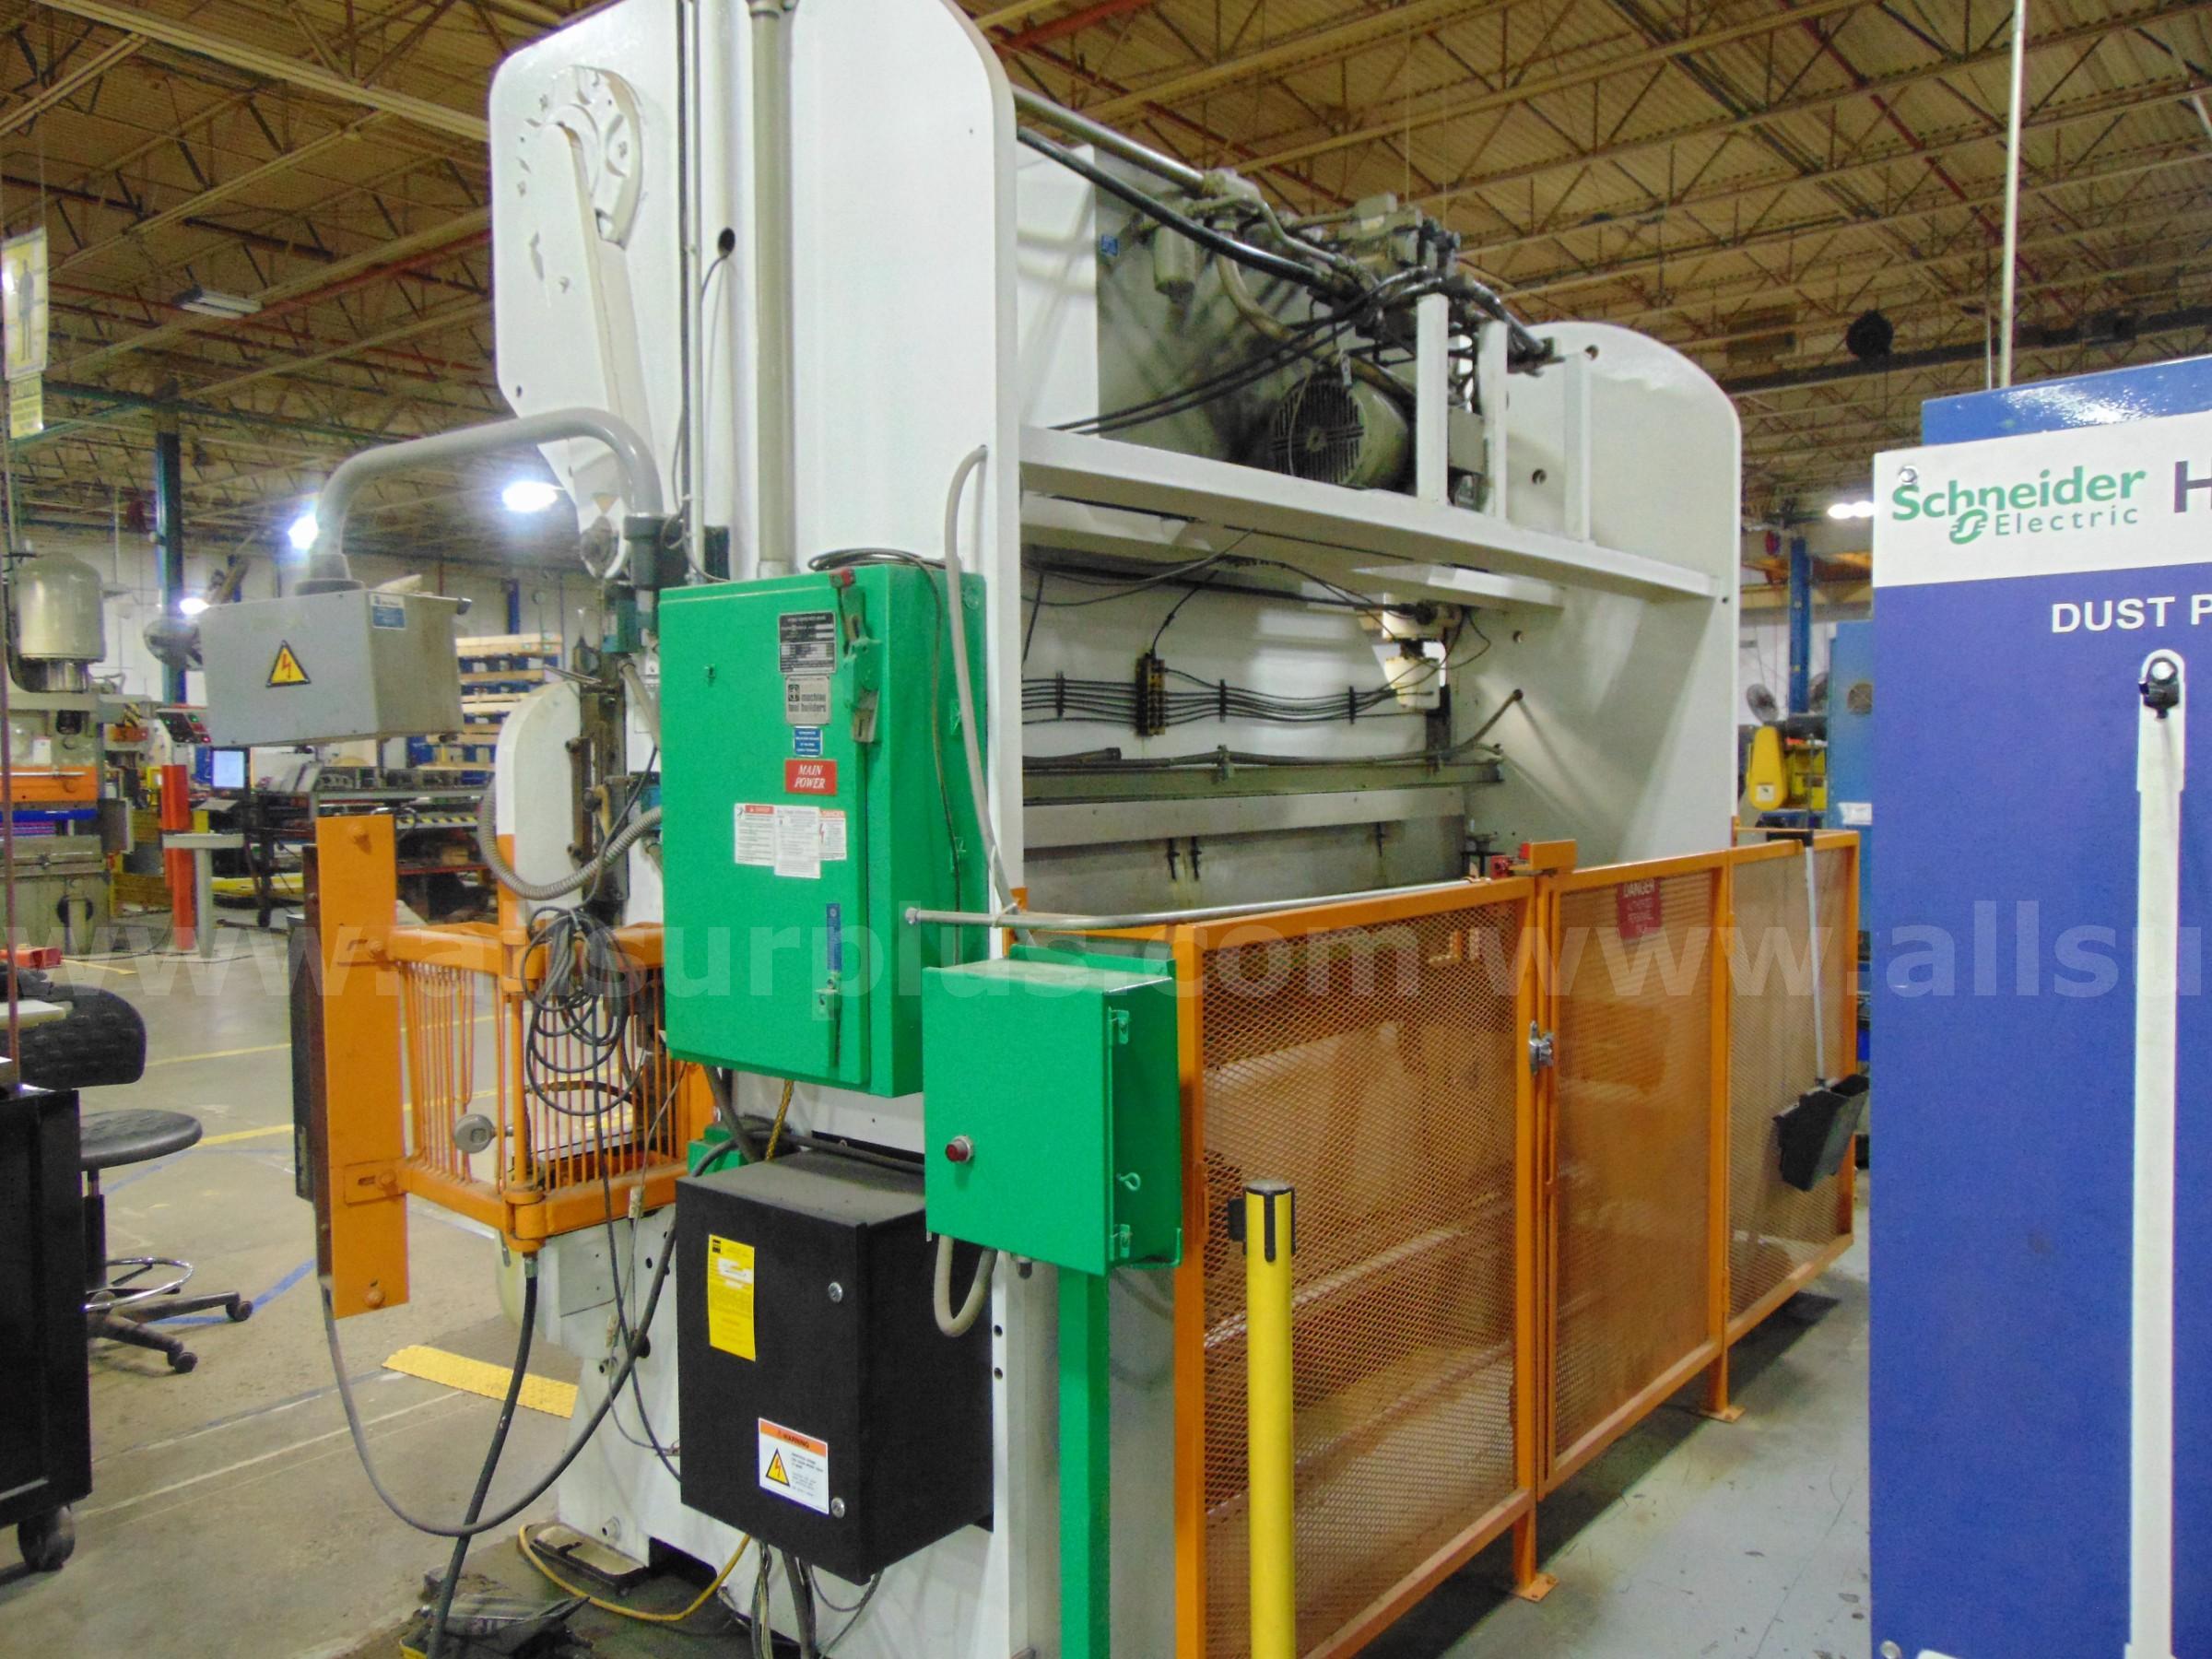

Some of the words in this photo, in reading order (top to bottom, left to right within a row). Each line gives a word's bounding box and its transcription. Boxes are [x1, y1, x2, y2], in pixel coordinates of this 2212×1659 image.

[1892, 465, 2147, 521] Schneider
[1994, 505, 2138, 535] Electric
[2052, 596, 2176, 633] DUST
[794, 776, 827, 790] POWER
[797, 764, 824, 776] MAIN
